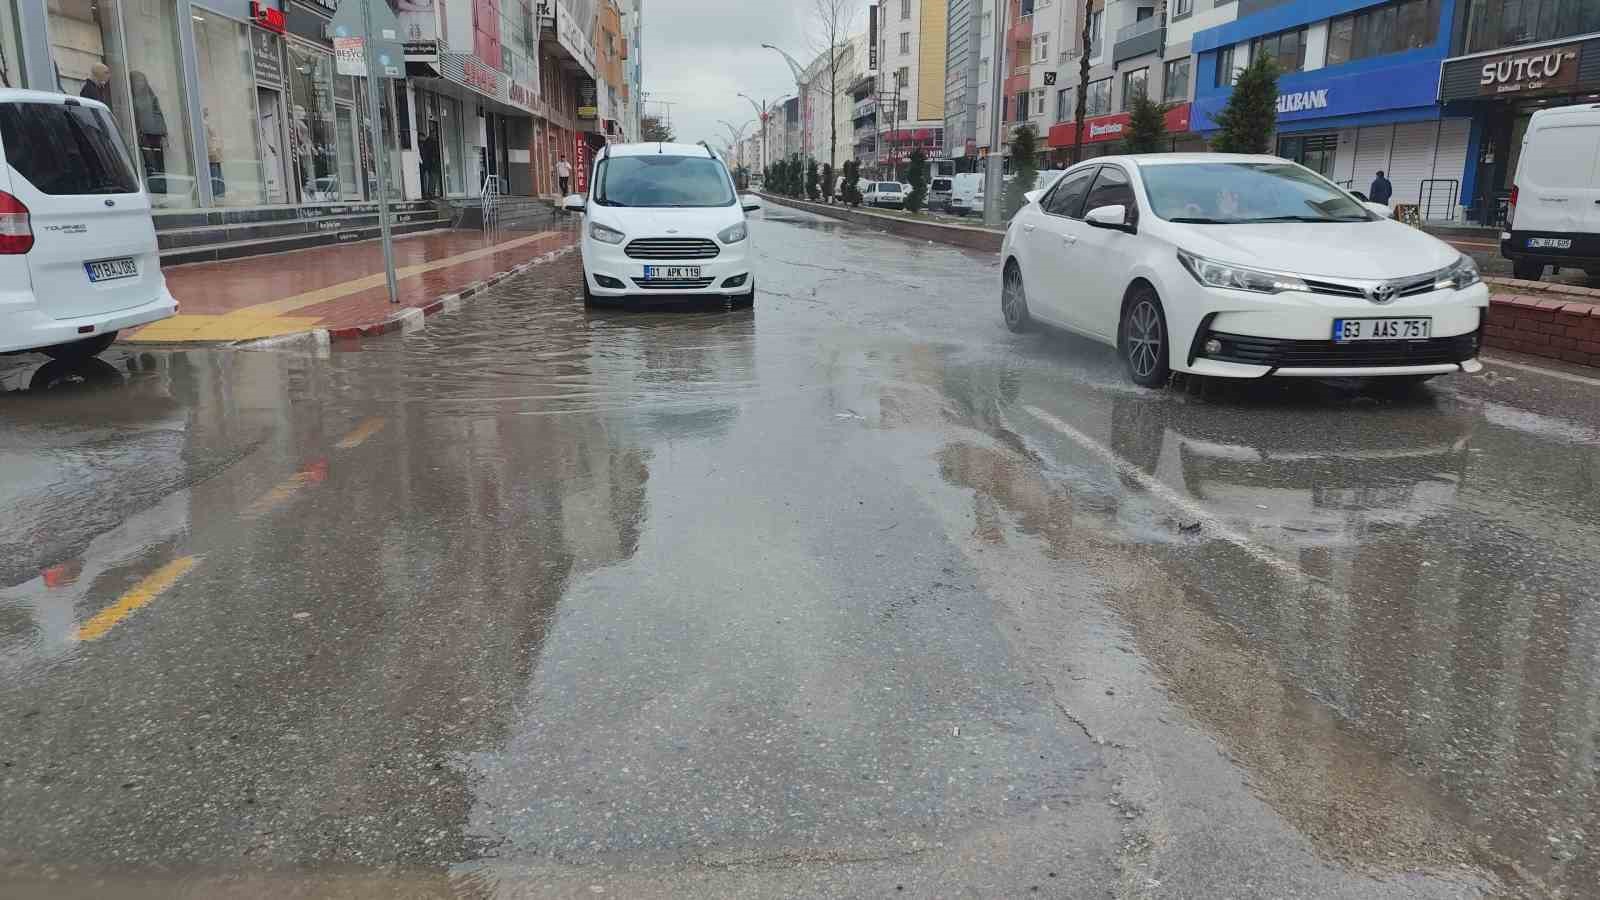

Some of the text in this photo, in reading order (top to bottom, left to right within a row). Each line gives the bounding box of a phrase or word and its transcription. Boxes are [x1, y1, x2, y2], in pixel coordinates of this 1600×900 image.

[1274, 89, 1328, 112] ALKBANK
[650, 267, 699, 278] 01 APK 119
[1343, 320, 1428, 338] 63 AAS 751
